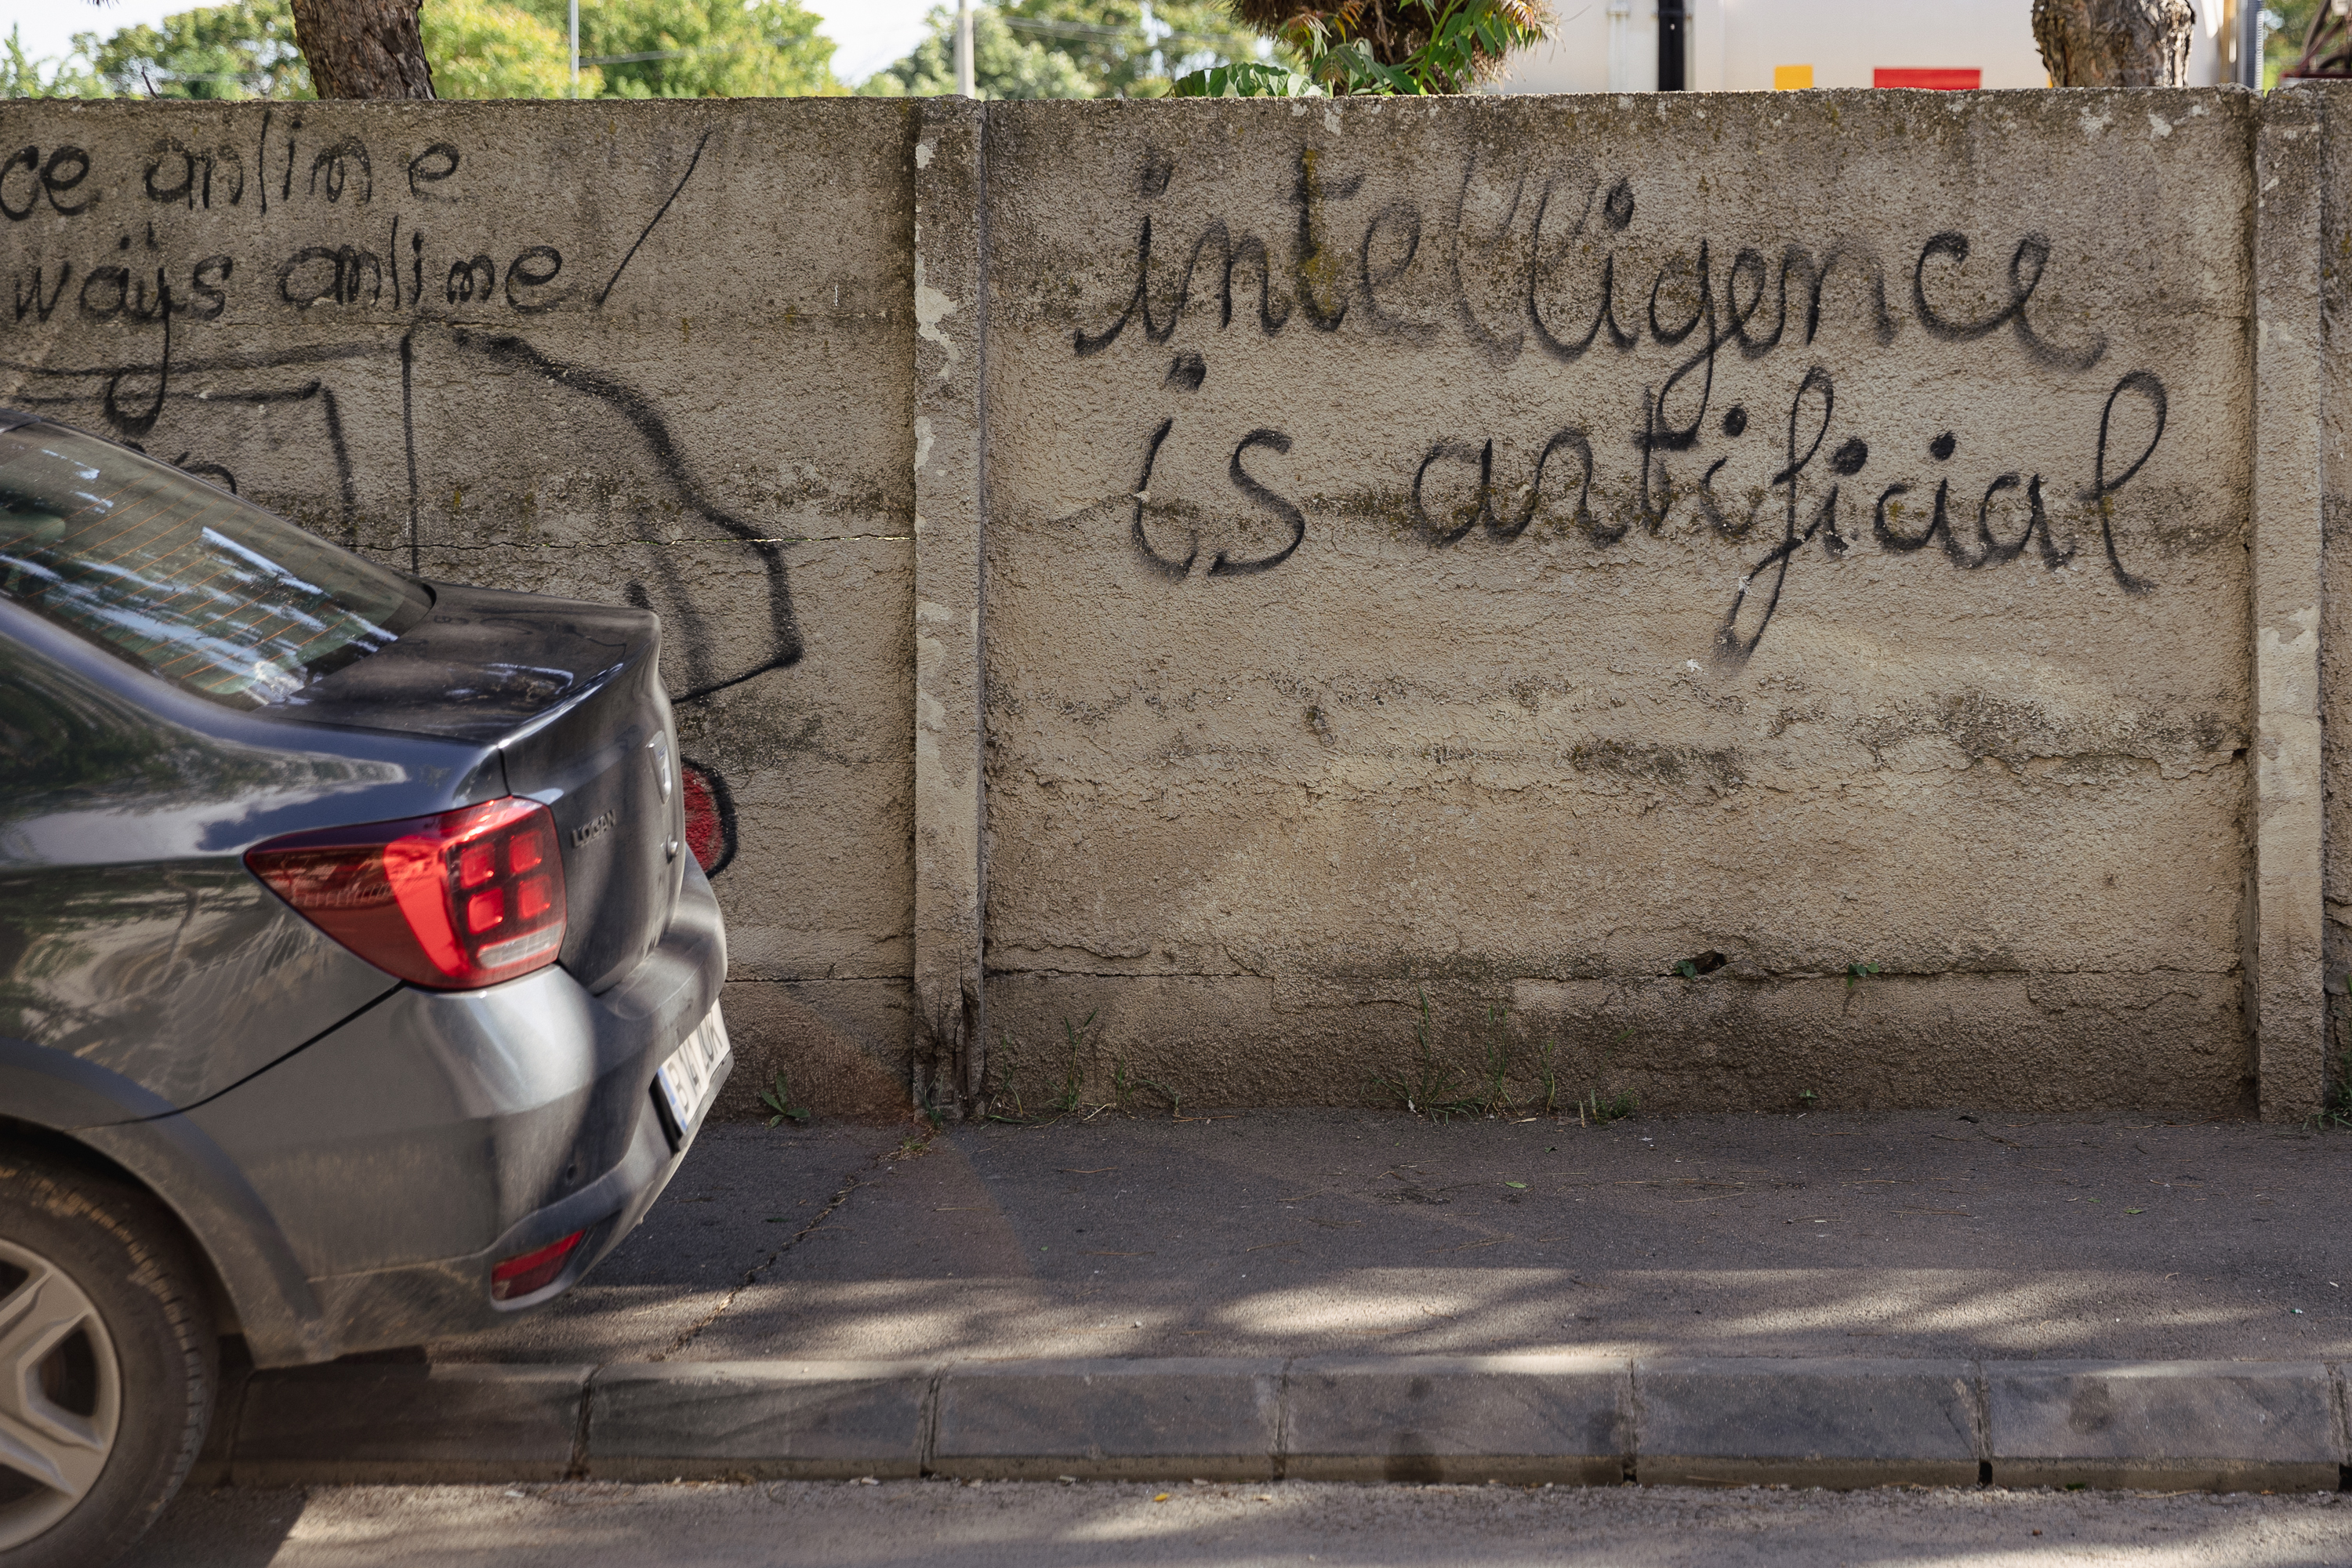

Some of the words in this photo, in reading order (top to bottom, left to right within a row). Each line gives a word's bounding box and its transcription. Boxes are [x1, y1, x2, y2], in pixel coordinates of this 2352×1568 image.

[1074, 143, 2108, 449] intelligence
[1131, 350, 1306, 582] is
[1412, 365, 2169, 671] artificial
[571, 808, 617, 848] LOGAN
